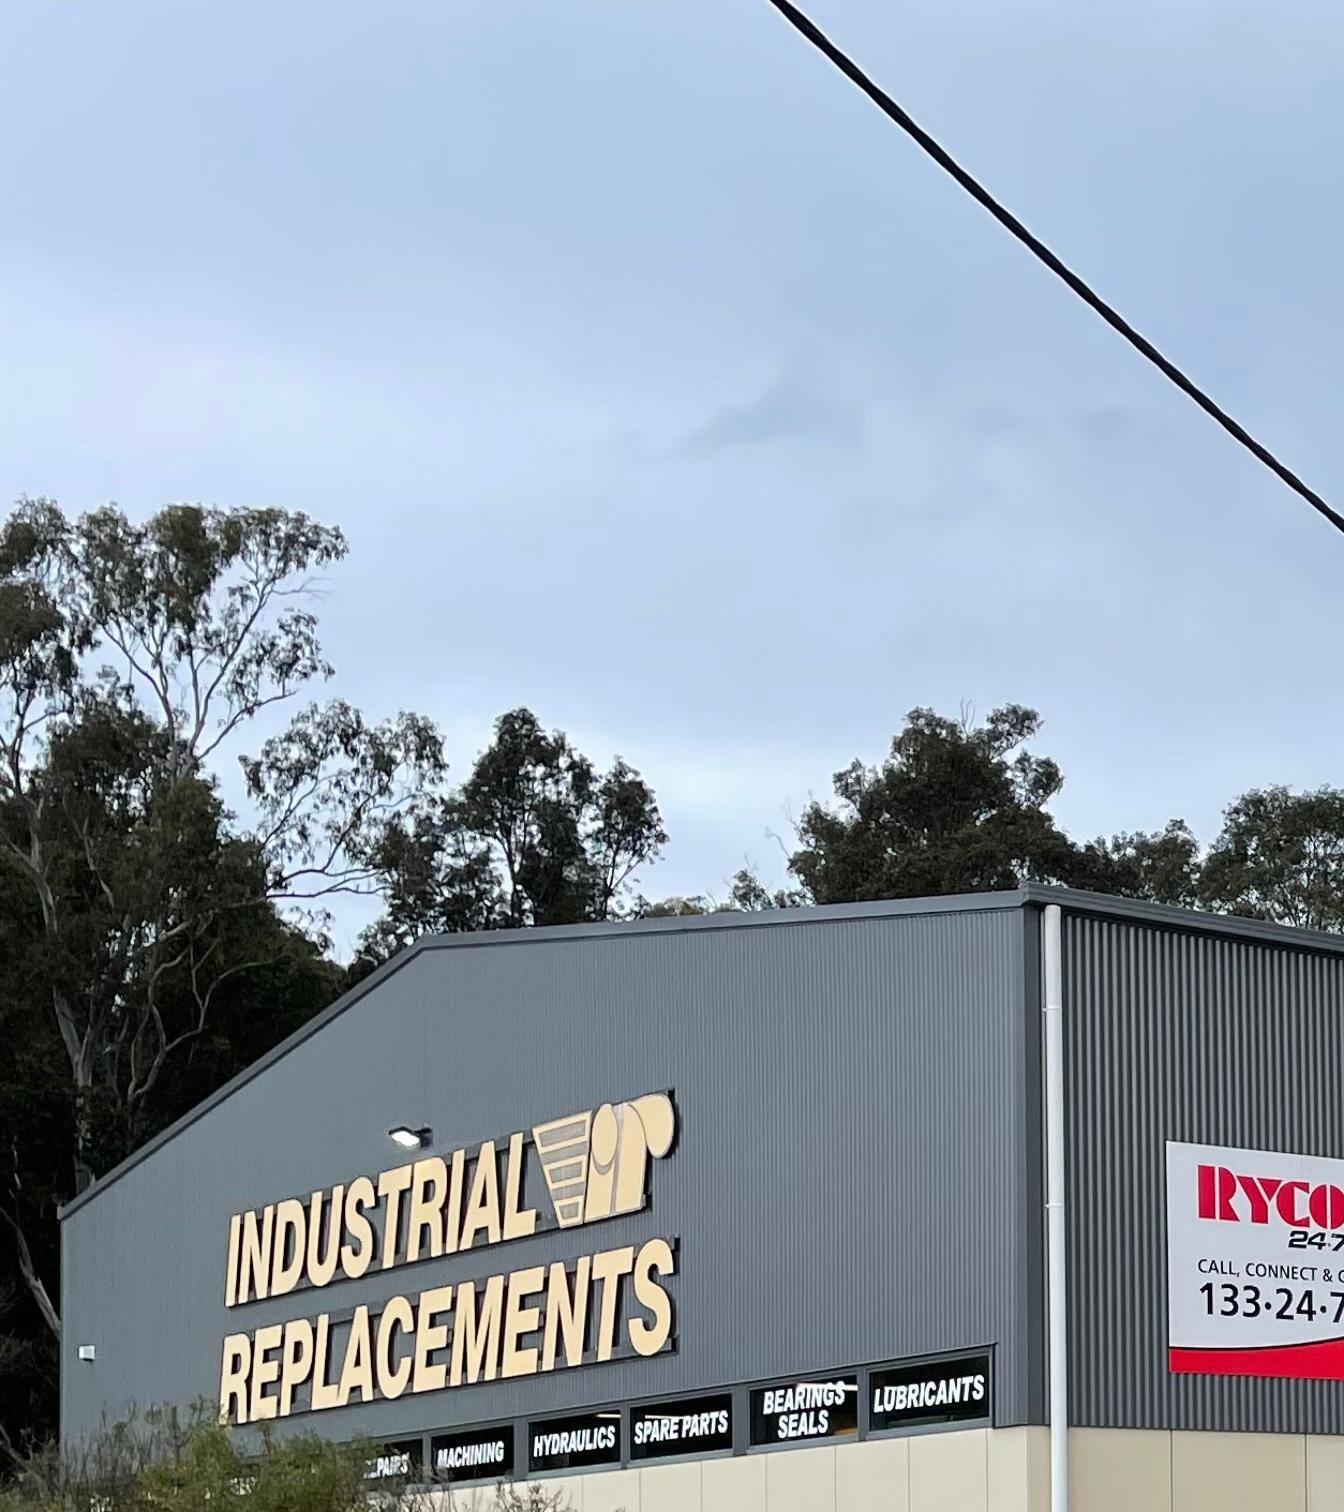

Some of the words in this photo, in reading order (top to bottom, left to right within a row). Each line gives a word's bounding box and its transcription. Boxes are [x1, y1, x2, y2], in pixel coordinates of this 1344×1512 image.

[225, 1131, 537, 1306] INDUSTRIAL
[1197, 1258, 1241, 1278] CALL,
[1245, 1262, 1318, 1281] CONNECT
[1322, 1267, 1333, 1283] &
[218, 1237, 674, 1425] REPLACEMENTS
[763, 1381, 846, 1415] BEARINGS
[873, 1374, 986, 1414] LUBRICANTS
[533, 1425, 616, 1457] HYDRAULICS
[634, 1417, 680, 1445] SPARE
[681, 1410, 729, 1438] PARTS
[777, 1410, 830, 1439] SEALS
[437, 1441, 505, 1469] MACHINING
